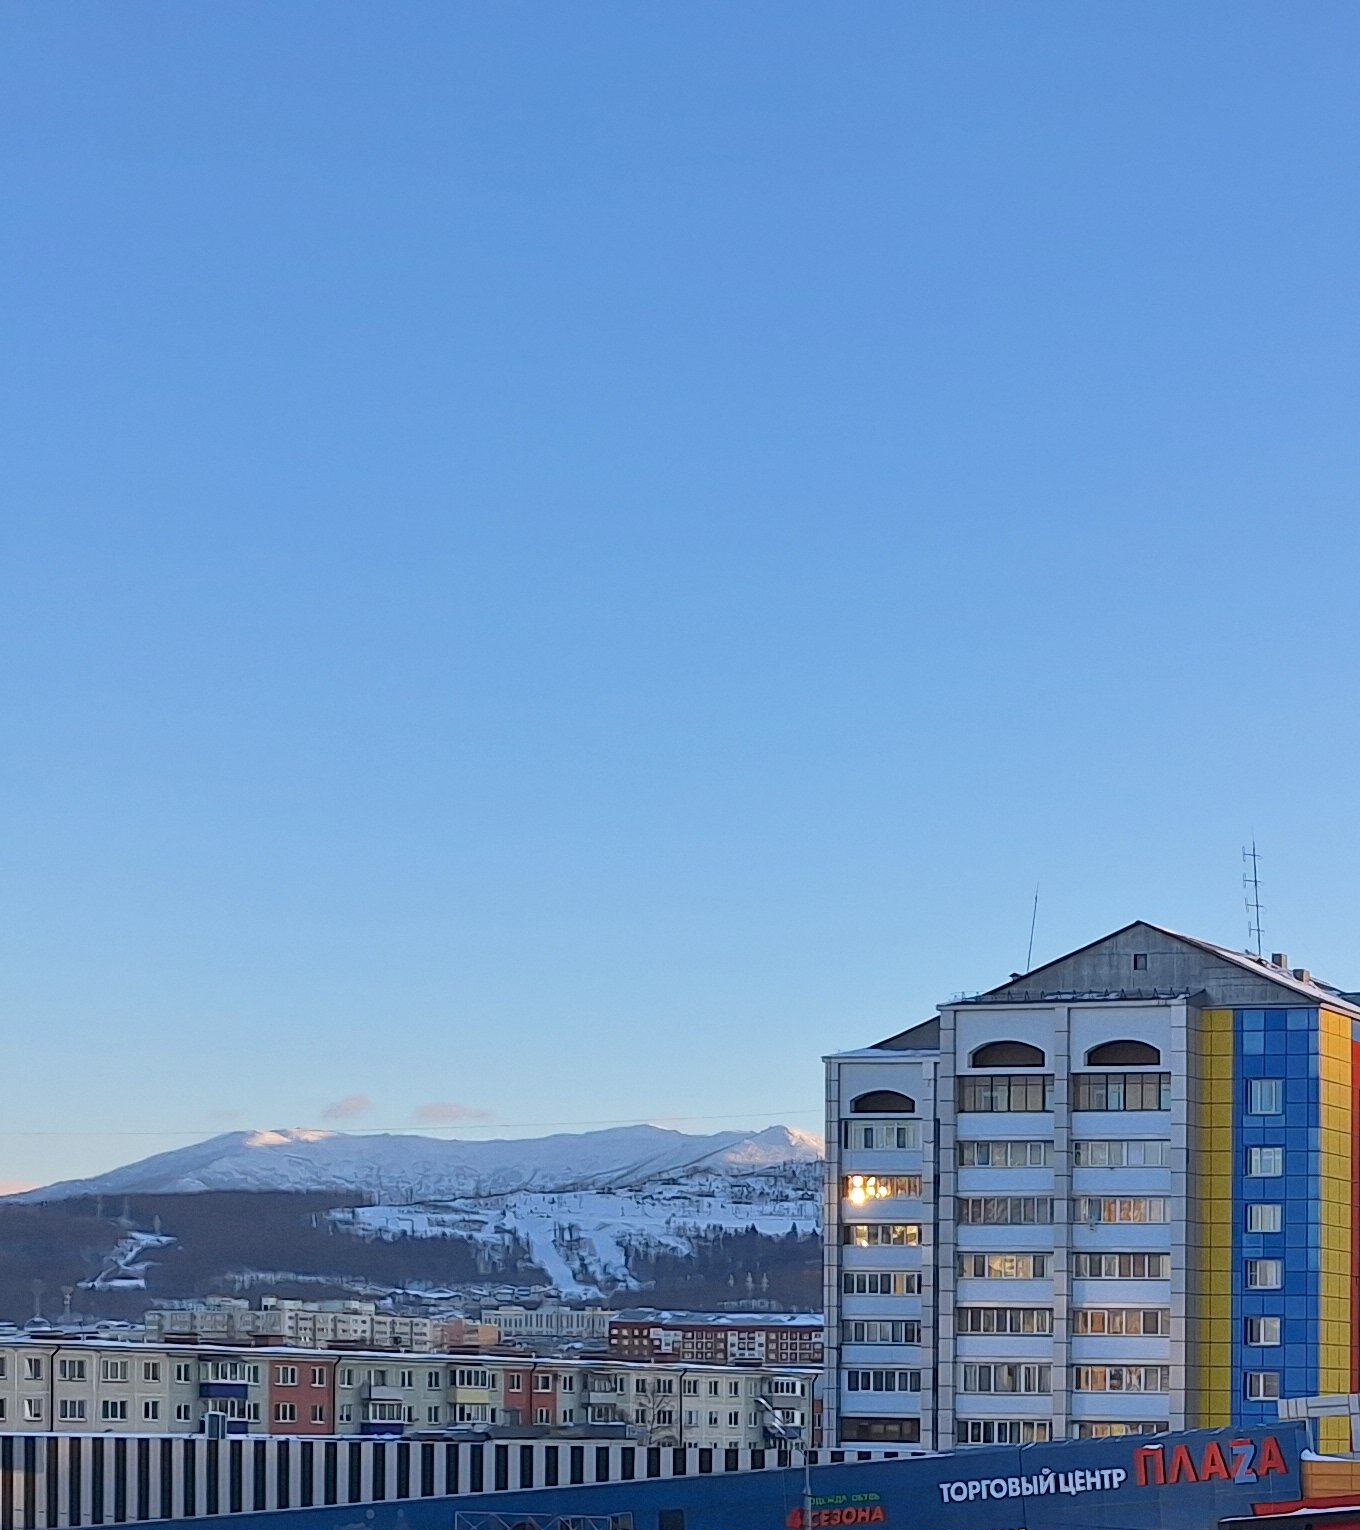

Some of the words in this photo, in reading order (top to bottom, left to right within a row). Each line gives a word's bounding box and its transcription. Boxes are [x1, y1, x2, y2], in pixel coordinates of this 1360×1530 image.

[939, 1468, 1056, 1503] ТОРГОВЫЙ
[1058, 1468, 1127, 1496] ЦЕНТР
[810, 1505, 885, 1527] СЕЗОНА
